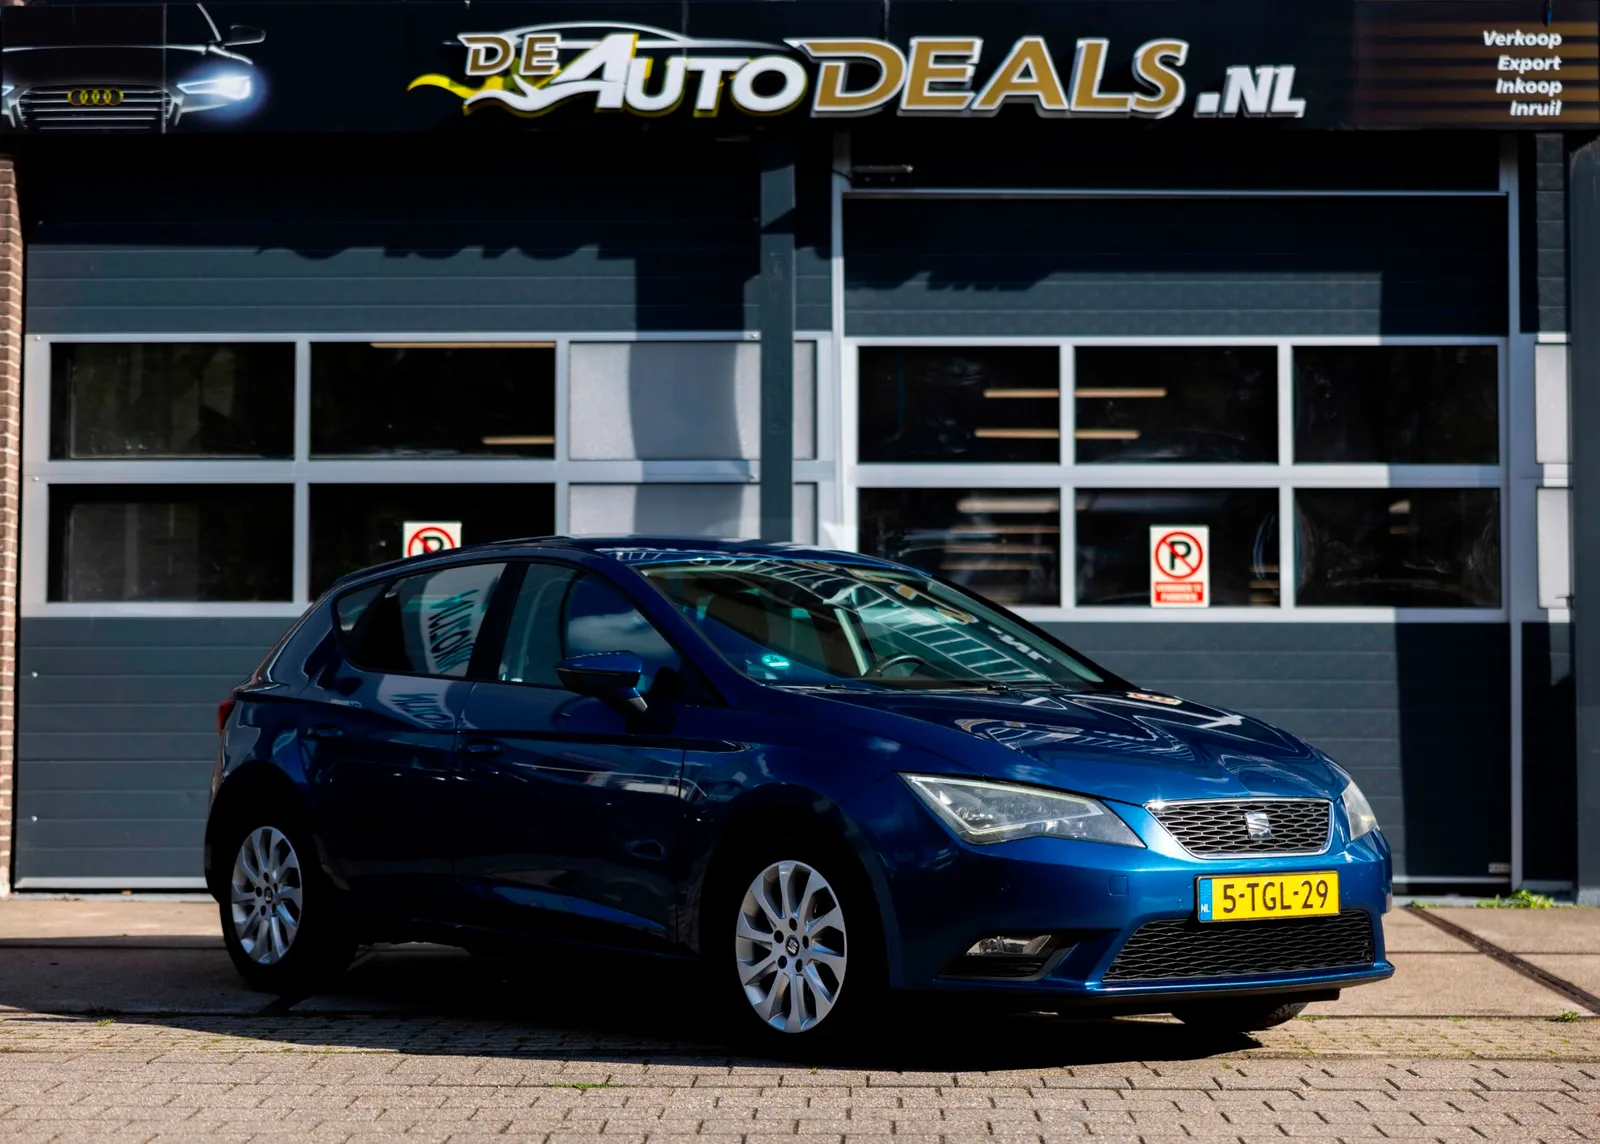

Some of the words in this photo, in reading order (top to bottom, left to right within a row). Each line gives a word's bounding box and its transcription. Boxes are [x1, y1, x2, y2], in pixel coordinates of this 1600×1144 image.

[1483, 29, 1562, 49] Verkoop
[458, 33, 561, 76] DE
[1497, 54, 1562, 74] Export
[1496, 77, 1563, 97] Inkoop
[1510, 100, 1562, 116] Inruil
[1200, 903, 1211, 913] NL
[1222, 880, 1329, 914] 5-TGL-29
